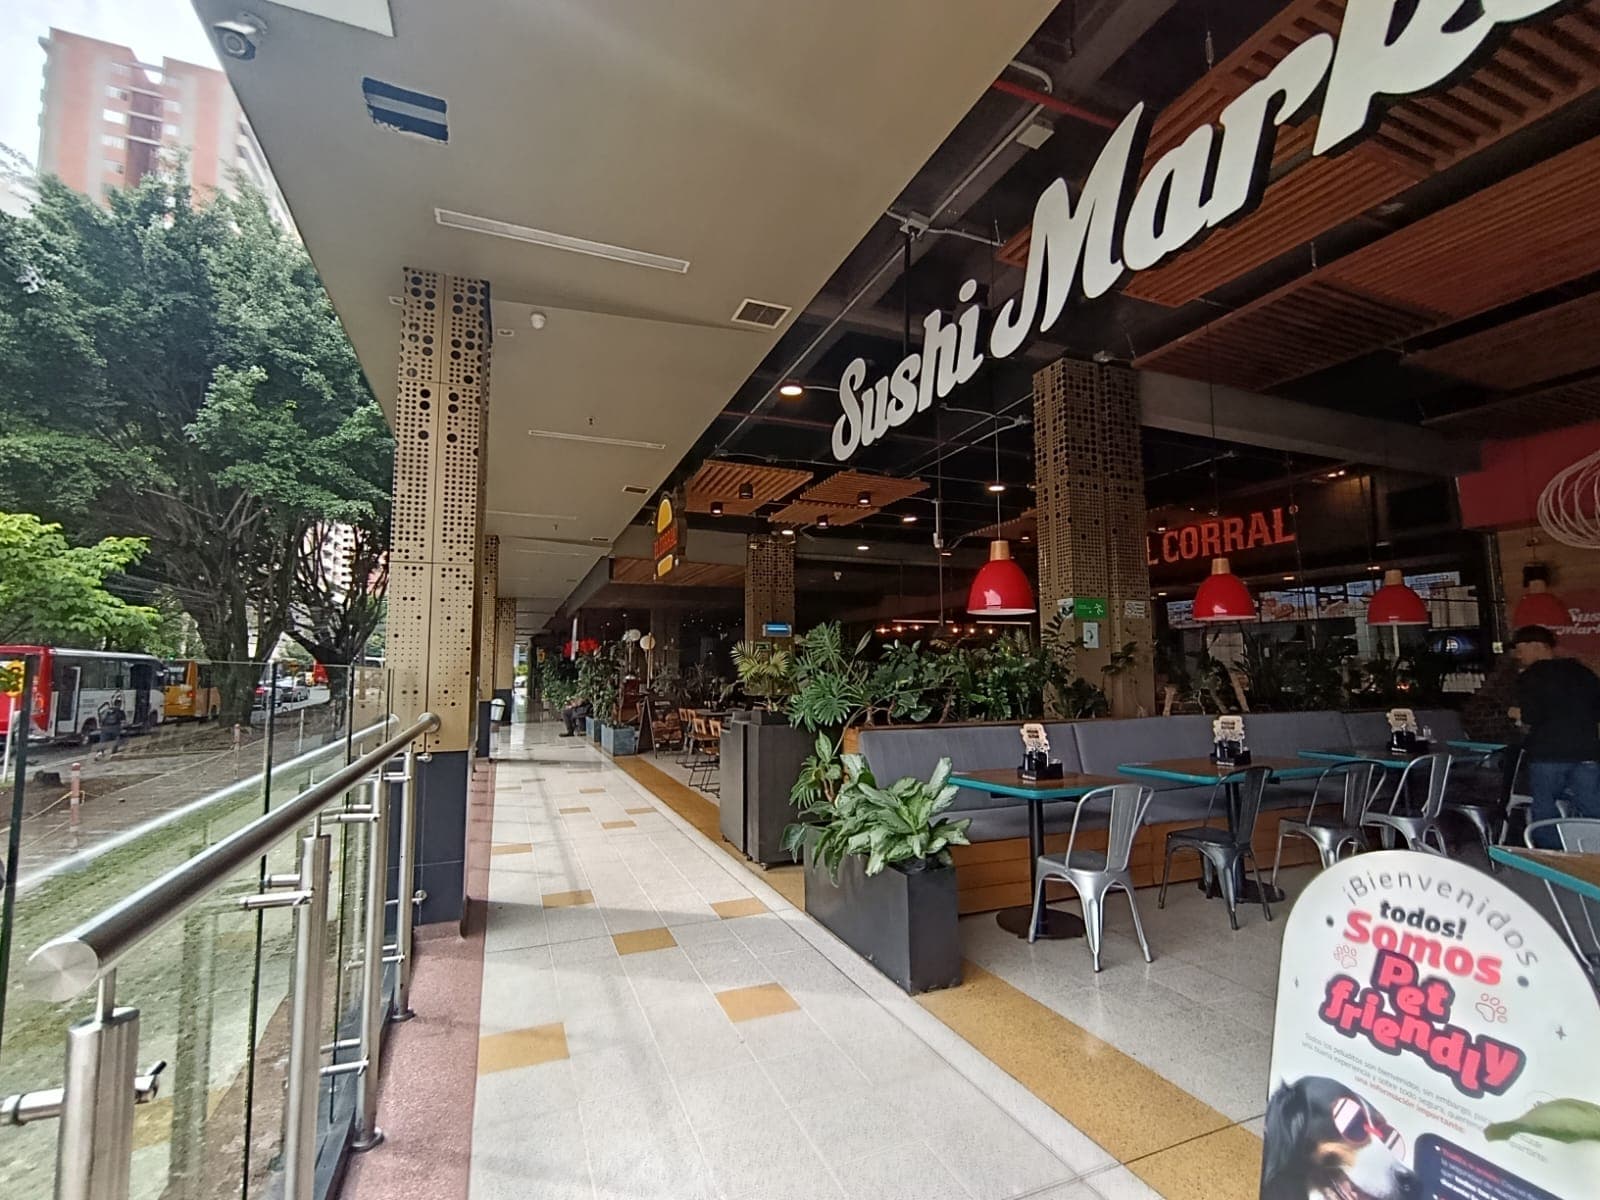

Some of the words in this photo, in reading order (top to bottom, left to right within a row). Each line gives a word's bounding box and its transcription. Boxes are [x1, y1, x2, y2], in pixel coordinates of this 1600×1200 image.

[832, 279, 984, 462] Sushi
[1162, 507, 1297, 564] CORRAL
[1342, 871, 1539, 968] ¡Bienvenidos
[1343, 909, 1503, 986] Somos
[1380, 899, 1467, 941] todos!
[1374, 953, 1451, 1019] Pet
[1323, 978, 1521, 1092] friendly
